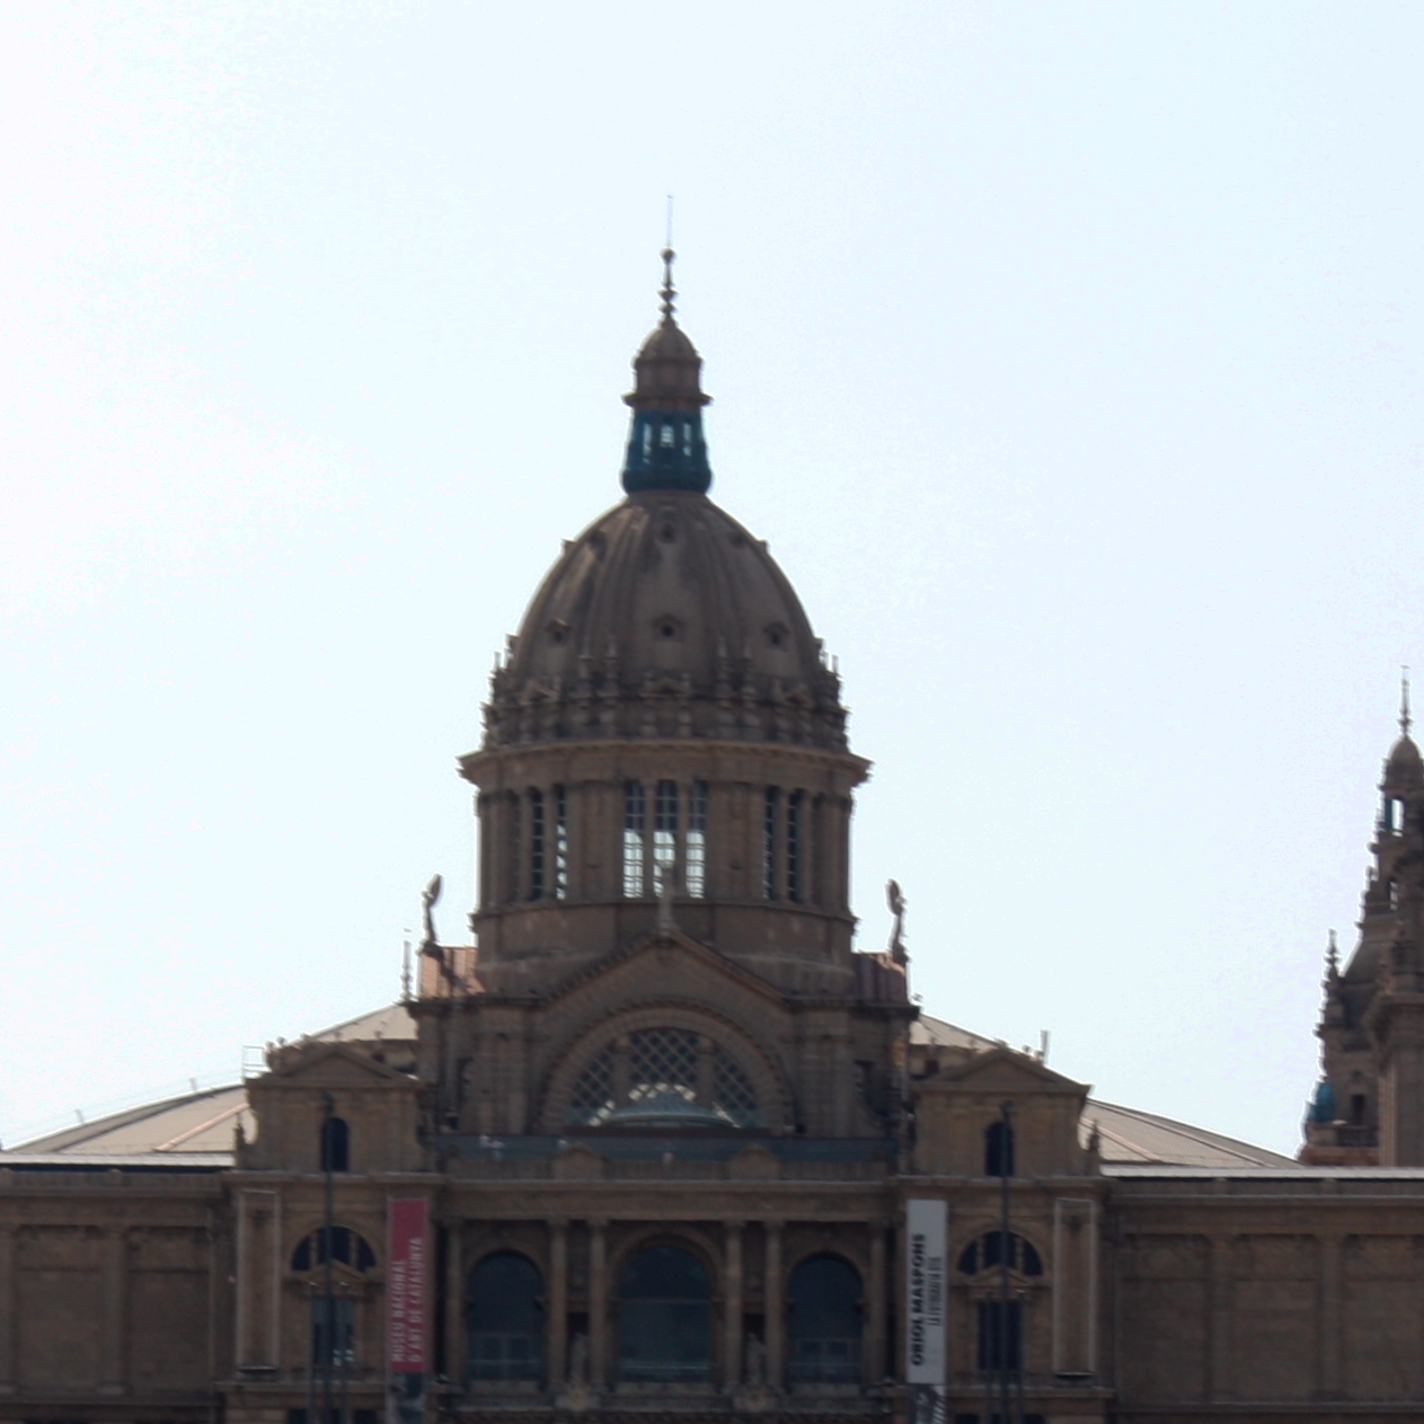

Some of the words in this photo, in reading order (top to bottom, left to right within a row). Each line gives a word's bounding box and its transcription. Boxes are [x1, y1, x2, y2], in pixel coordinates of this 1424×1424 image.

[390, 1259, 405, 1318] NACIONAL
[408, 1238, 424, 1304] CATALUNYA
[911, 1233, 924, 1312] MASPONS
[390, 1322, 405, 1363] MUSEU
[408, 1310, 424, 1324] DE
[911, 1318, 924, 1365] ORIOL
